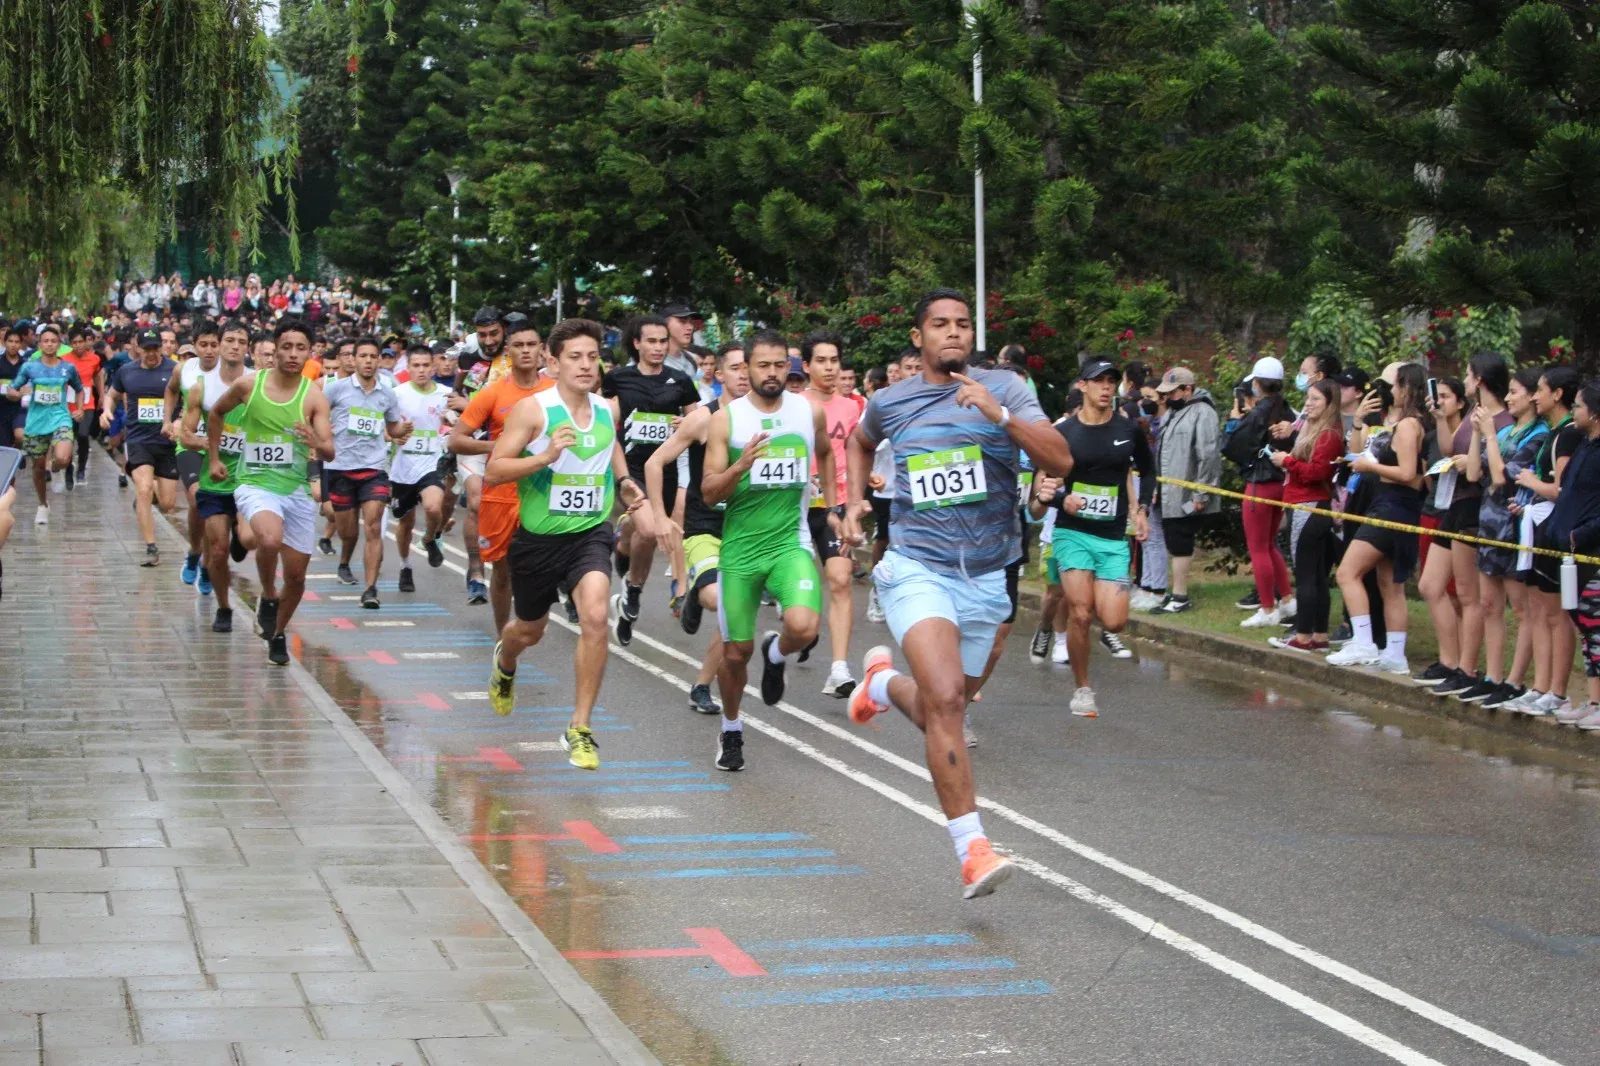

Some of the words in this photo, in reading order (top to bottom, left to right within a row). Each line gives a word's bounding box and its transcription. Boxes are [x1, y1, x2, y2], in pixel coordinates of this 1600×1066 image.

[140, 408, 165, 418] 281
[357, 418, 372, 430] 96
[639, 425, 667, 439] 488
[416, 439, 423, 450] 5
[254, 446, 284, 461] 182
[760, 463, 794, 480] 441
[917, 468, 977, 498] 1031
[560, 490, 593, 508] 351
